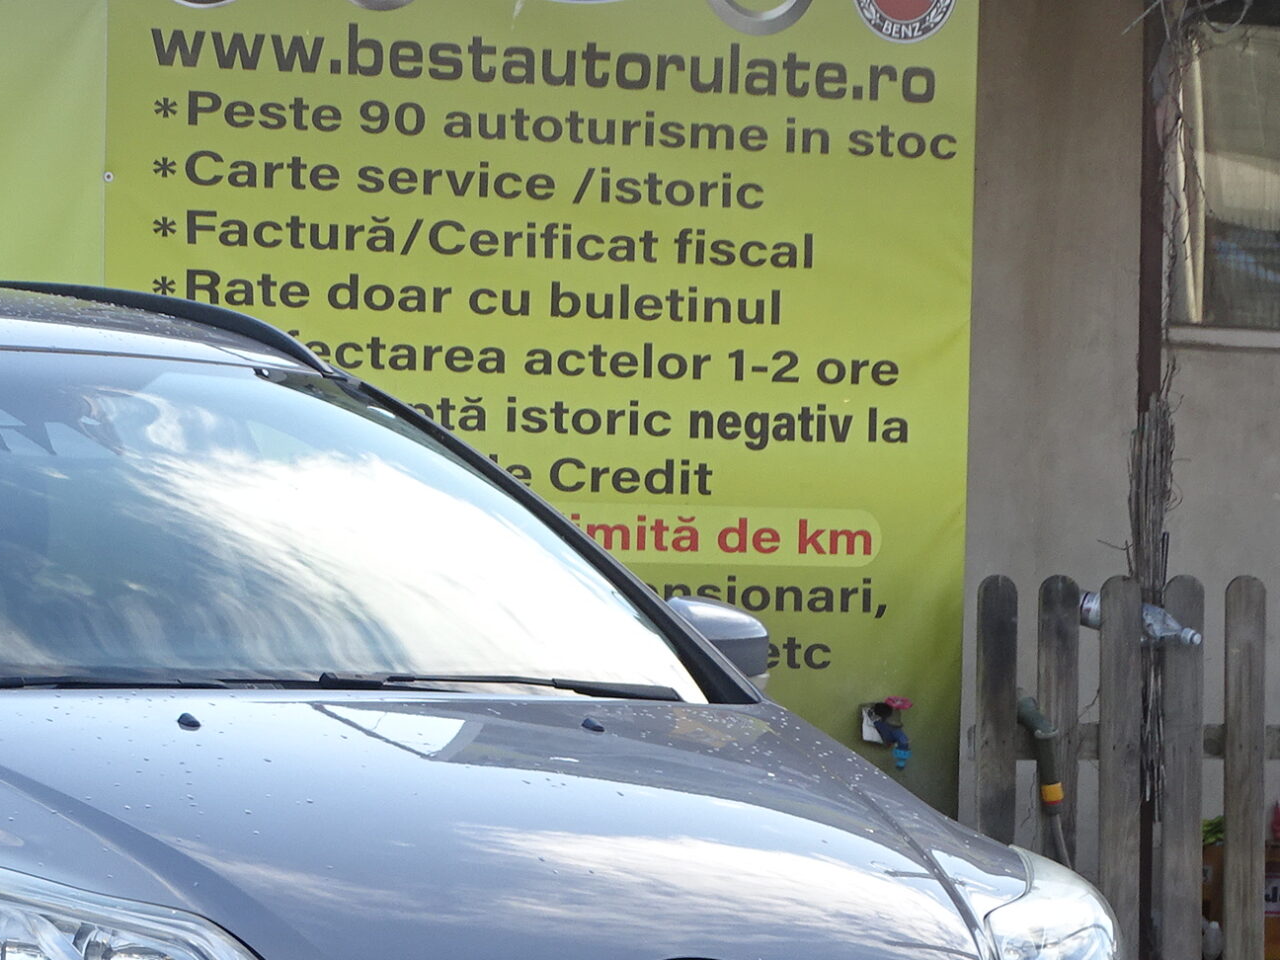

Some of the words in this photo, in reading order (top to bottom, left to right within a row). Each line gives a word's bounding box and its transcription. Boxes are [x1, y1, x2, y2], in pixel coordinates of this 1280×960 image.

[882, 20, 922, 38] BENZ
[151, 24, 936, 104] www.bestautorulate.ro
[360, 101, 425, 136] 90
[444, 108, 768, 151] autoturisme
[786, 118, 829, 154] in
[849, 125, 956, 160] stoc
[358, 162, 555, 200] service
[573, 167, 763, 209] /istoric
[674, 228, 812, 268] fiscal
[327, 274, 452, 313] doar
[470, 287, 530, 316] cu
[550, 278, 782, 326] buletinul
[287, 331, 505, 373] ectarea
[524, 342, 710, 380] actelor
[728, 348, 800, 384] 1-2
[815, 356, 899, 387] ore
[506, 396, 672, 437] istoric
[688, 401, 852, 450] negativ
[868, 408, 908, 443] la
[549, 457, 713, 496] Credit
[718, 517, 781, 554] de
[798, 518, 872, 555] km
